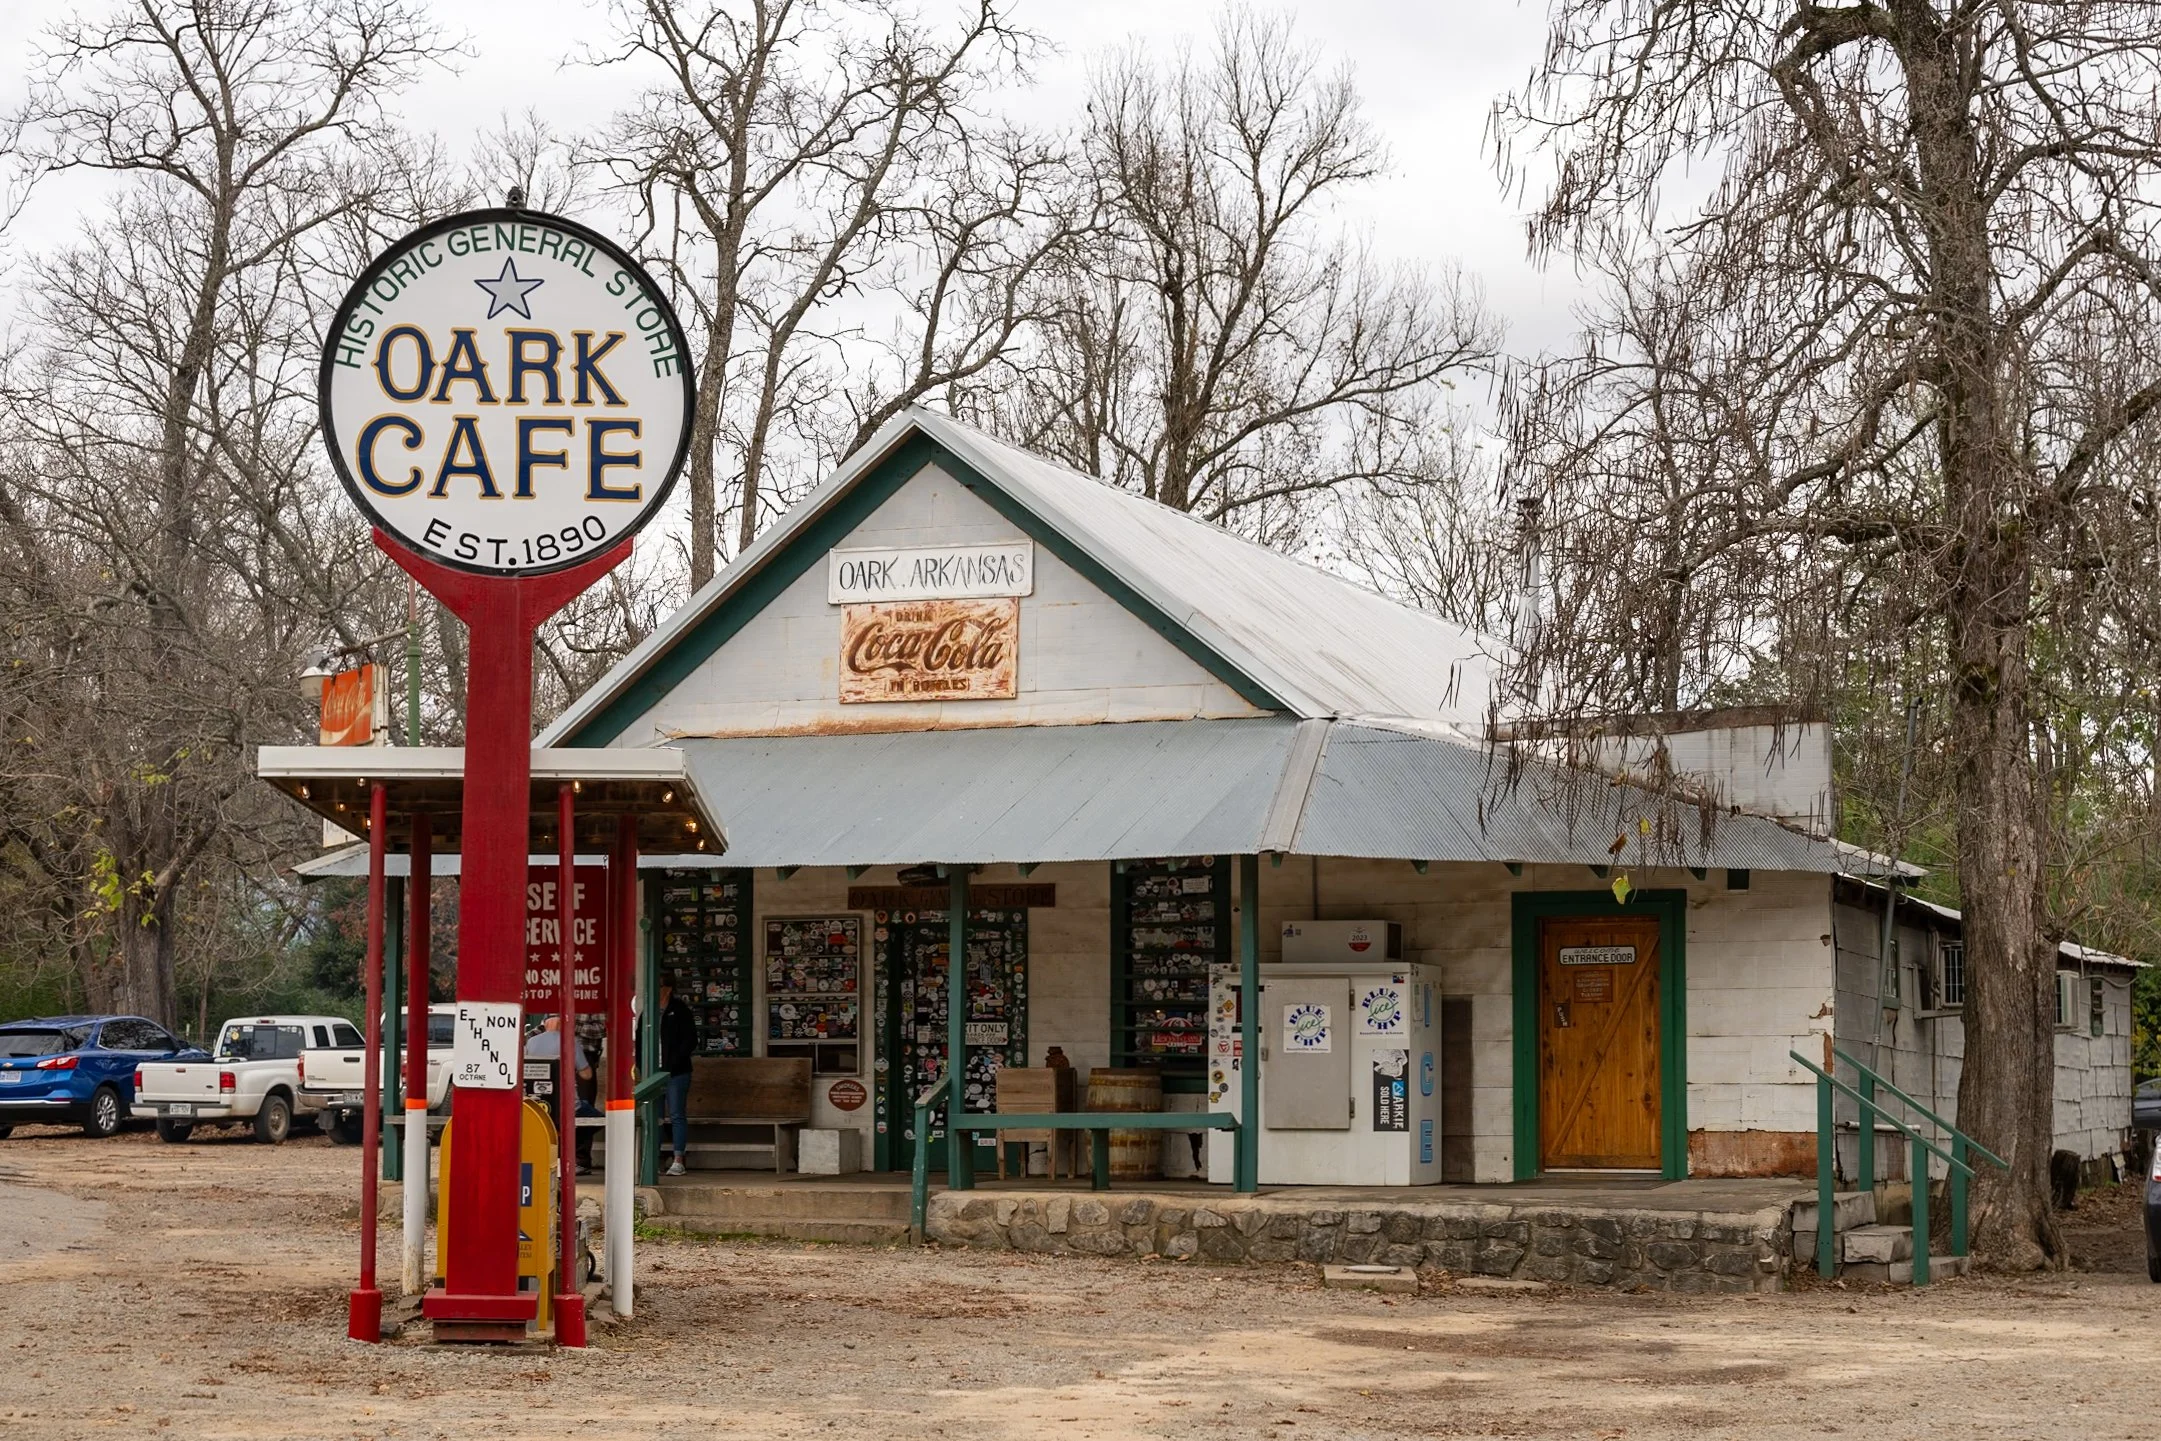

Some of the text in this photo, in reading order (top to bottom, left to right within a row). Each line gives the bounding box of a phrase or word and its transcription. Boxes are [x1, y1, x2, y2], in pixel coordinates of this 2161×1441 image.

[334, 223, 684, 379] HISTORIC GENERAL STORE
[371, 323, 629, 407] OARK
[355, 412, 643, 502] CAFE
[909, 553, 1025, 590] ARKANSAS
[895, 611, 933, 622] DRINK
[890, 679, 967, 693] IN BOTTLES
[526, 882, 586, 910] SEF
[1562, 953, 1633, 963] ENTRANCE DOOR
[541, 967, 600, 987] SMING
[1362, 987, 1399, 1009] BLUE
[1289, 1005, 1325, 1024] BLUE
[1368, 1001, 1399, 1017] ice
[486, 1015, 516, 1028] NON
[965, 1023, 1006, 1033] IT ONLY
[1367, 1010, 1401, 1030] CHIP
[1294, 1027, 1326, 1046] CHIP
[459, 1009, 515, 1085] ETHANOL
[459, 1073, 487, 1081] OCTANE
[466, 1064, 481, 1073] 87
[1380, 1086, 1390, 1125] SOLD HERE
[1392, 1096, 1405, 1129] ARKIE
